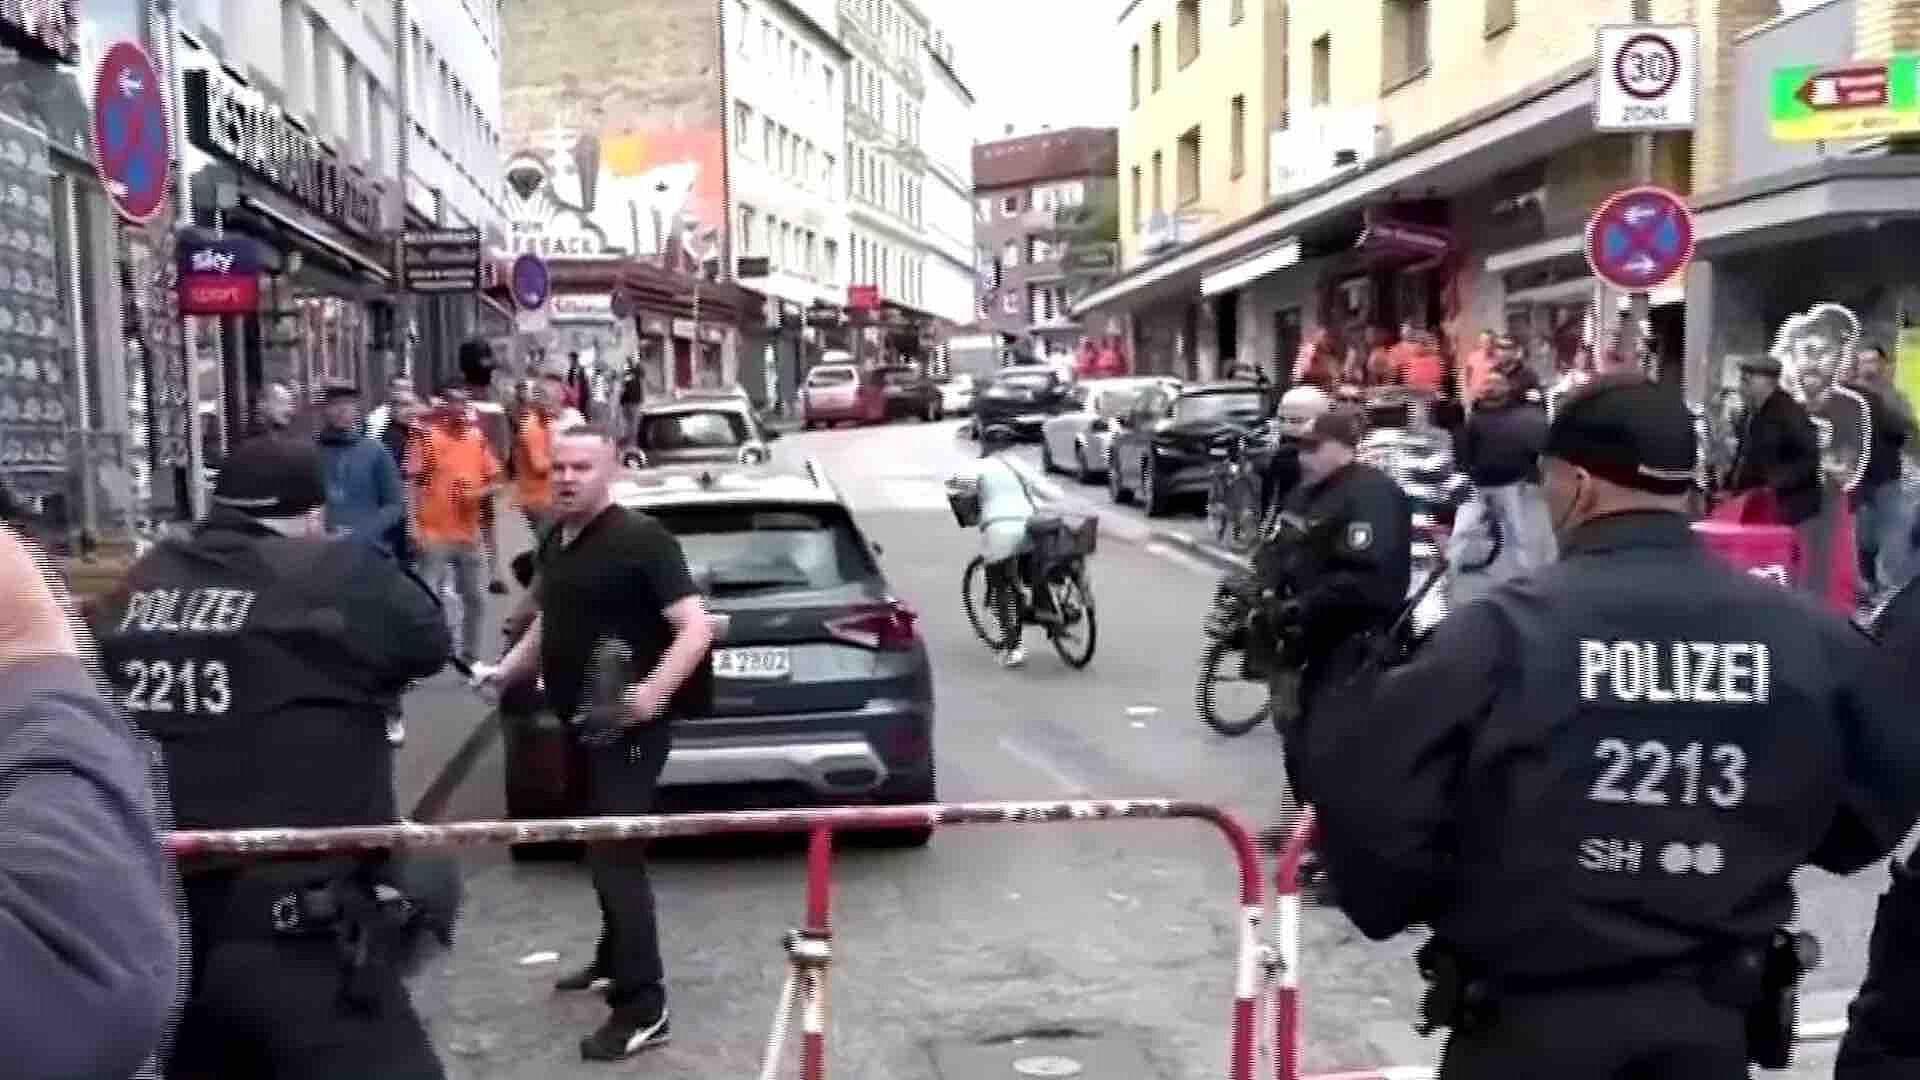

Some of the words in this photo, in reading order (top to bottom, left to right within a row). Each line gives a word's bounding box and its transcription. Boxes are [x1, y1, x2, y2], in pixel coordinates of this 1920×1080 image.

[1630, 52, 1665, 82] 30
[1622, 105, 1668, 121] ZONE
[191, 248, 235, 274] sky
[119, 587, 257, 633] POLIZEI
[123, 660, 232, 714] 2213
[1579, 639, 1770, 703] POLIZEI
[1587, 738, 1748, 808] 2213
[1578, 839, 1645, 874] SH
